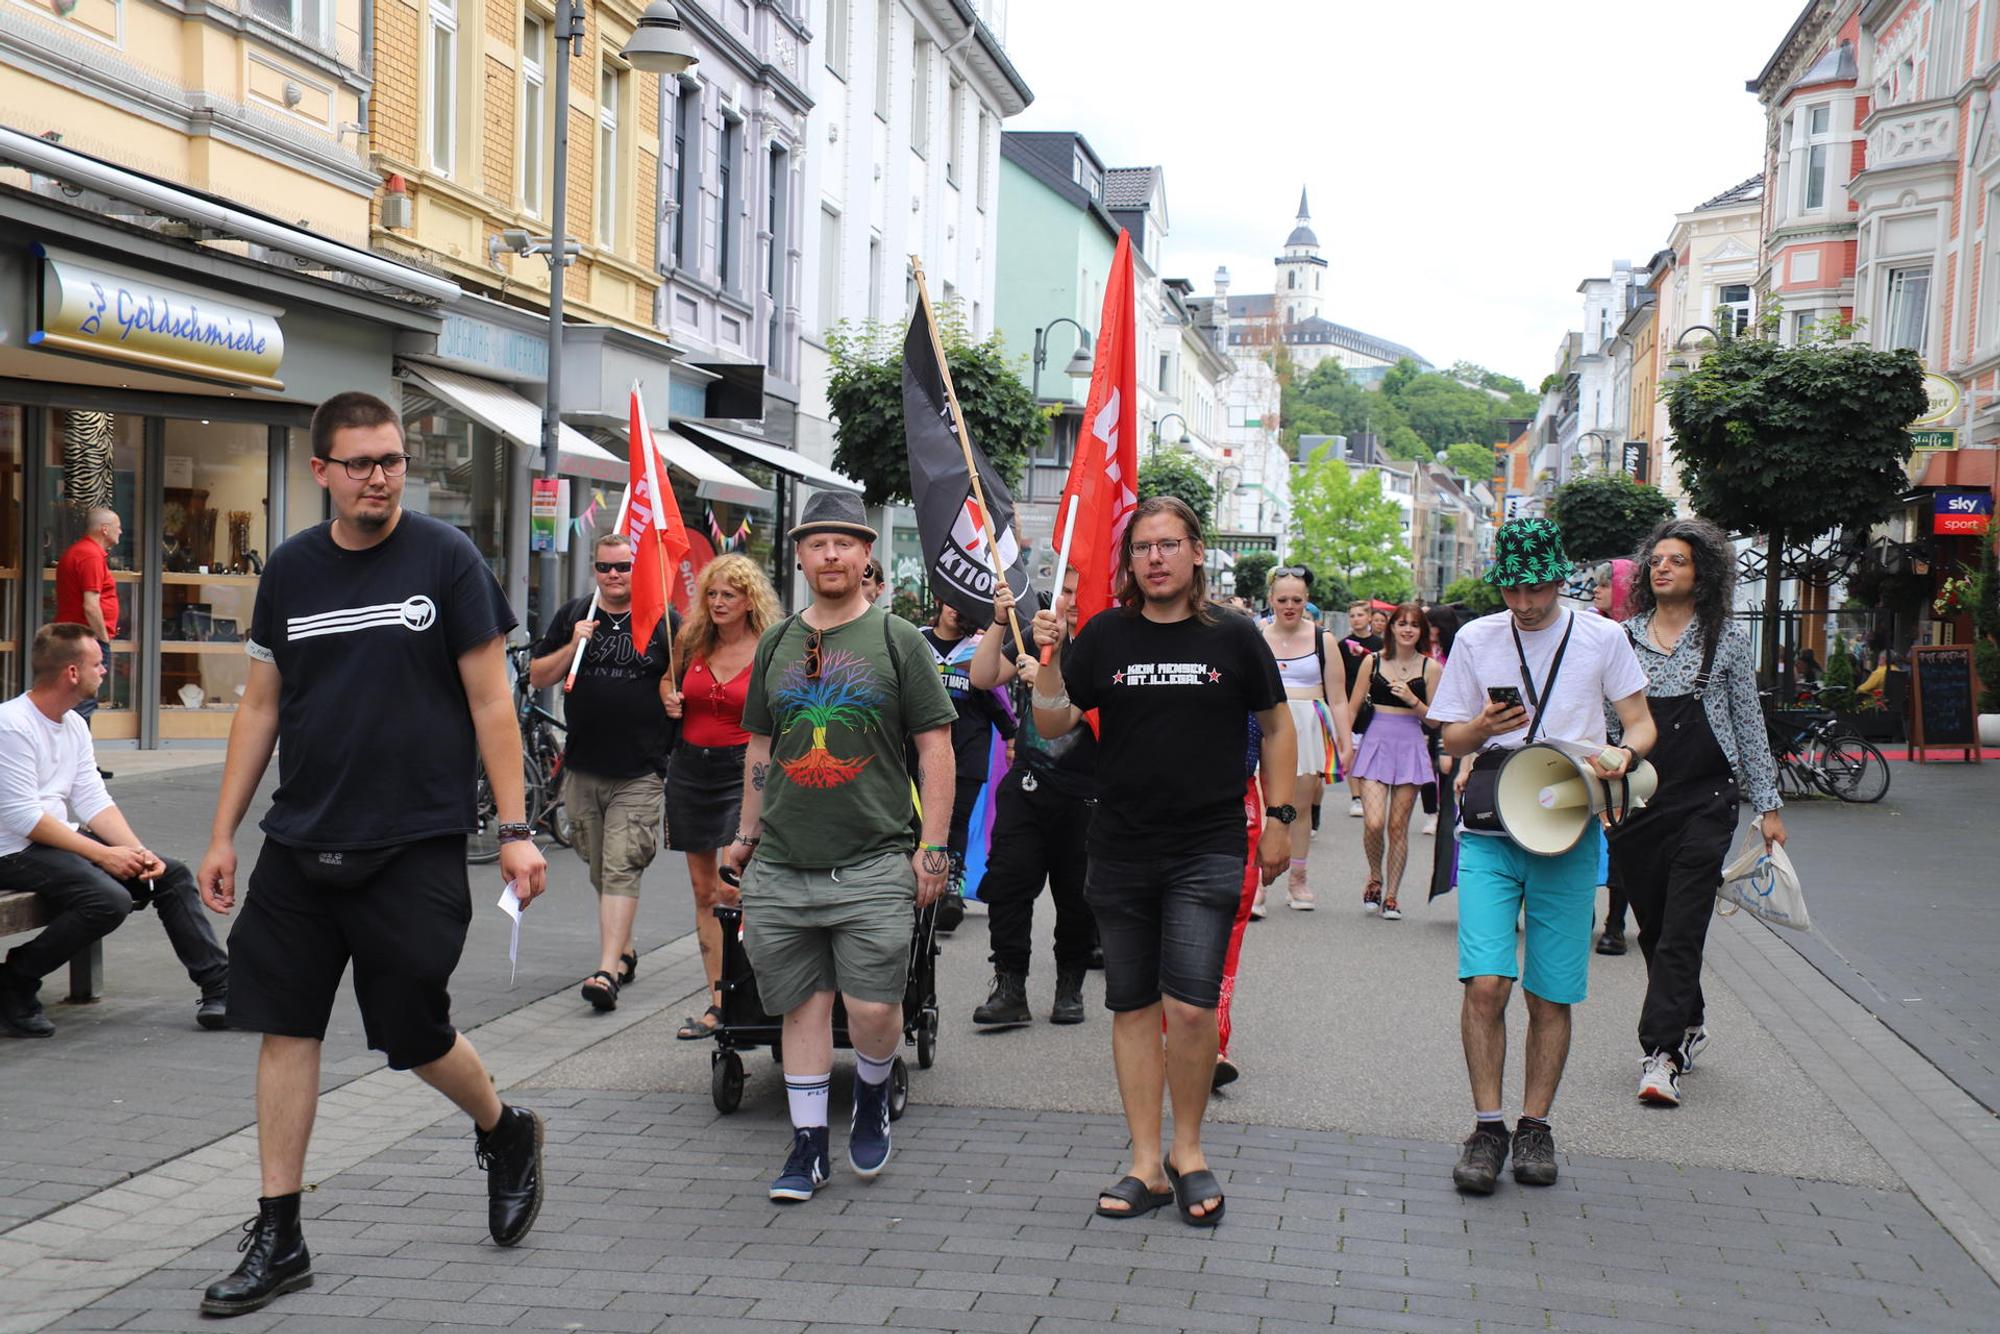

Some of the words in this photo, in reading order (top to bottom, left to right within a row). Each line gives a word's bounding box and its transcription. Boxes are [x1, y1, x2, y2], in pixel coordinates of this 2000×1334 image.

[117, 288, 265, 355] Goldschmiede
[1948, 496, 1978, 513] sky
[1944, 520, 1979, 530] sport
[939, 541, 999, 595] KTIO
[1127, 663, 1155, 675] KEIN
[1157, 663, 1207, 675] MENSCH
[1127, 674, 1147, 686] IST
[1150, 674, 1204, 685] ILLEGAL
